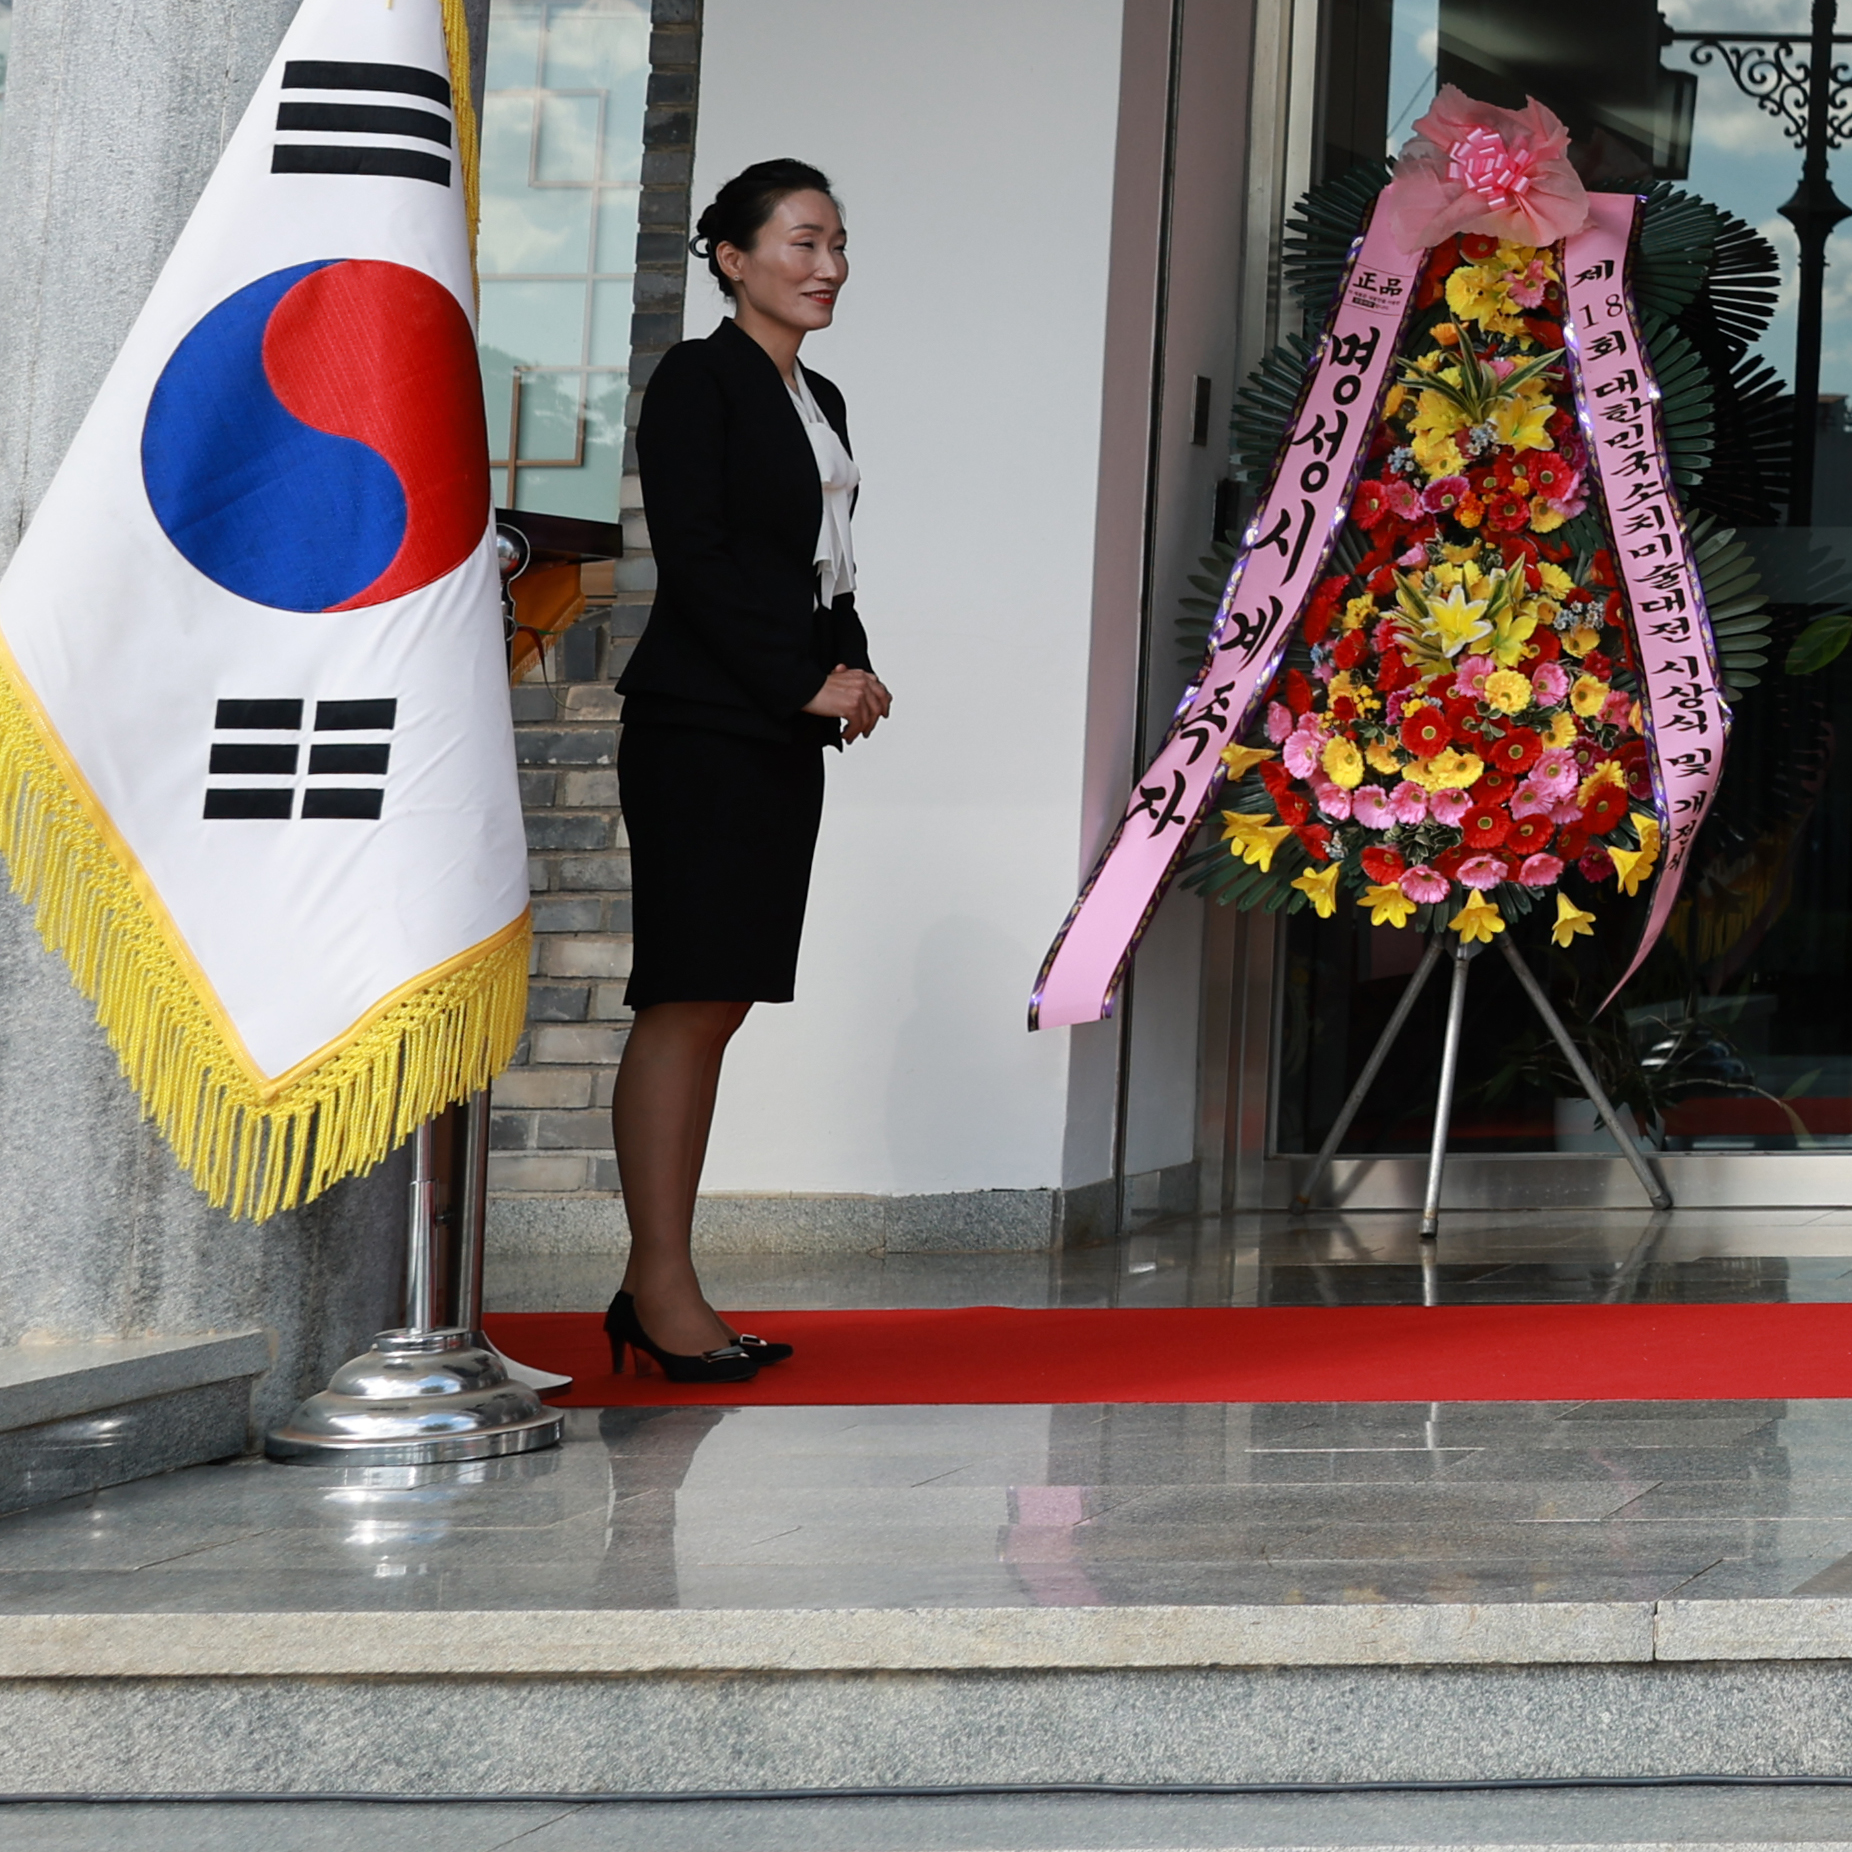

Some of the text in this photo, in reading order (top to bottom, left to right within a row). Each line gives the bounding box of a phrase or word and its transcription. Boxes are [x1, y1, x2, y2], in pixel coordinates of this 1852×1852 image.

[1352, 272, 1403, 297] 正品
[1651, 655, 1715, 736] 시상식
[1666, 748, 1712, 778] 및
